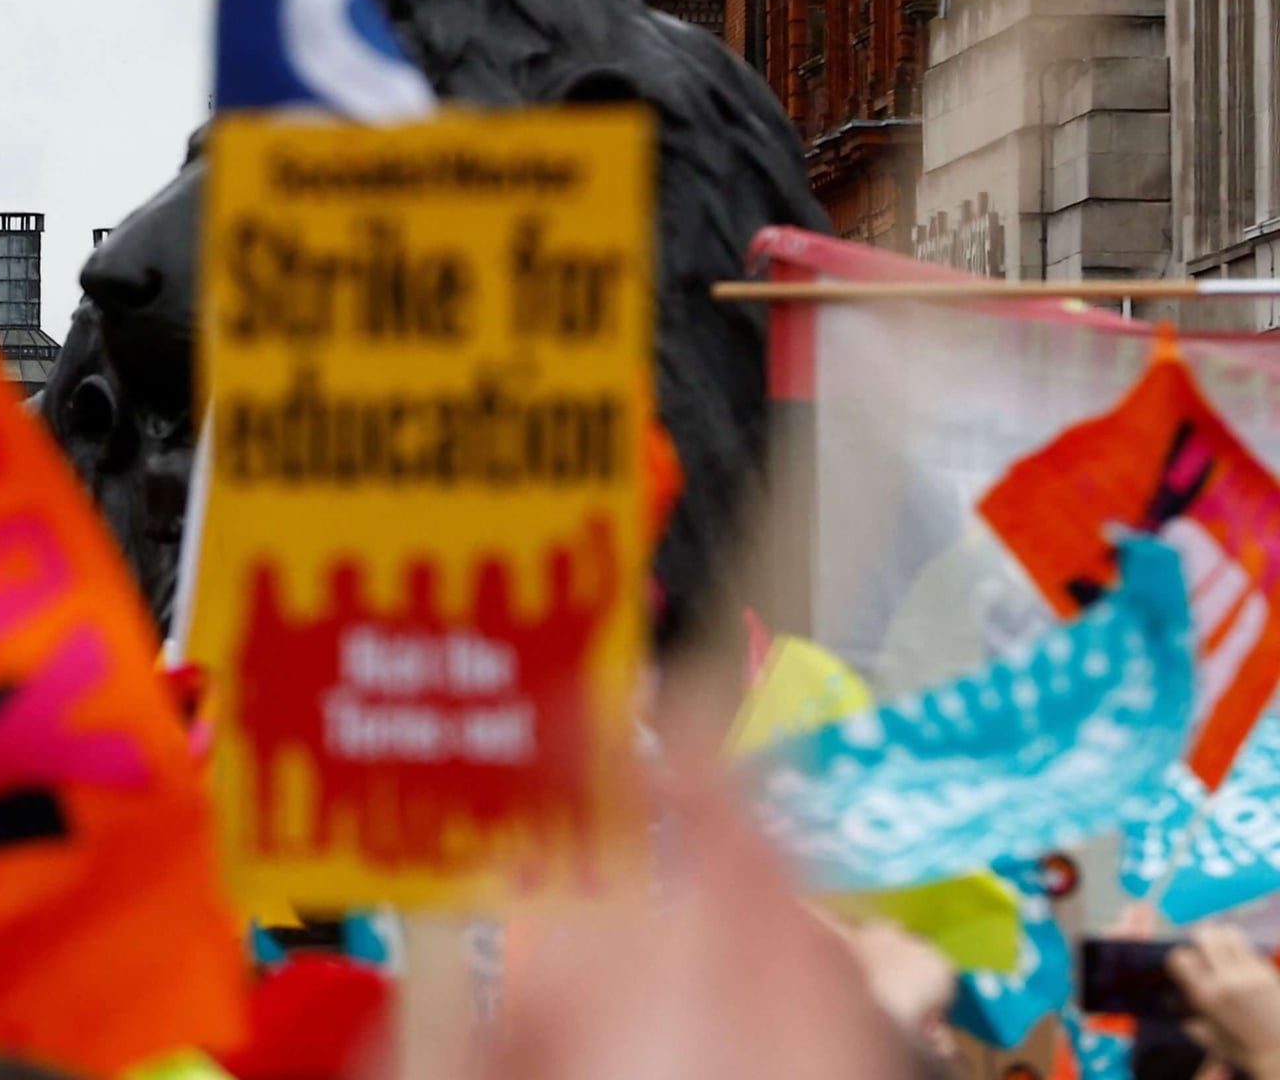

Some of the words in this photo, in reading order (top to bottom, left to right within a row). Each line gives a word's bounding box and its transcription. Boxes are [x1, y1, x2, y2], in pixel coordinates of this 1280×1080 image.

[224, 216, 470, 344] Strike
[506, 212, 627, 344] for
[222, 358, 628, 486] education
